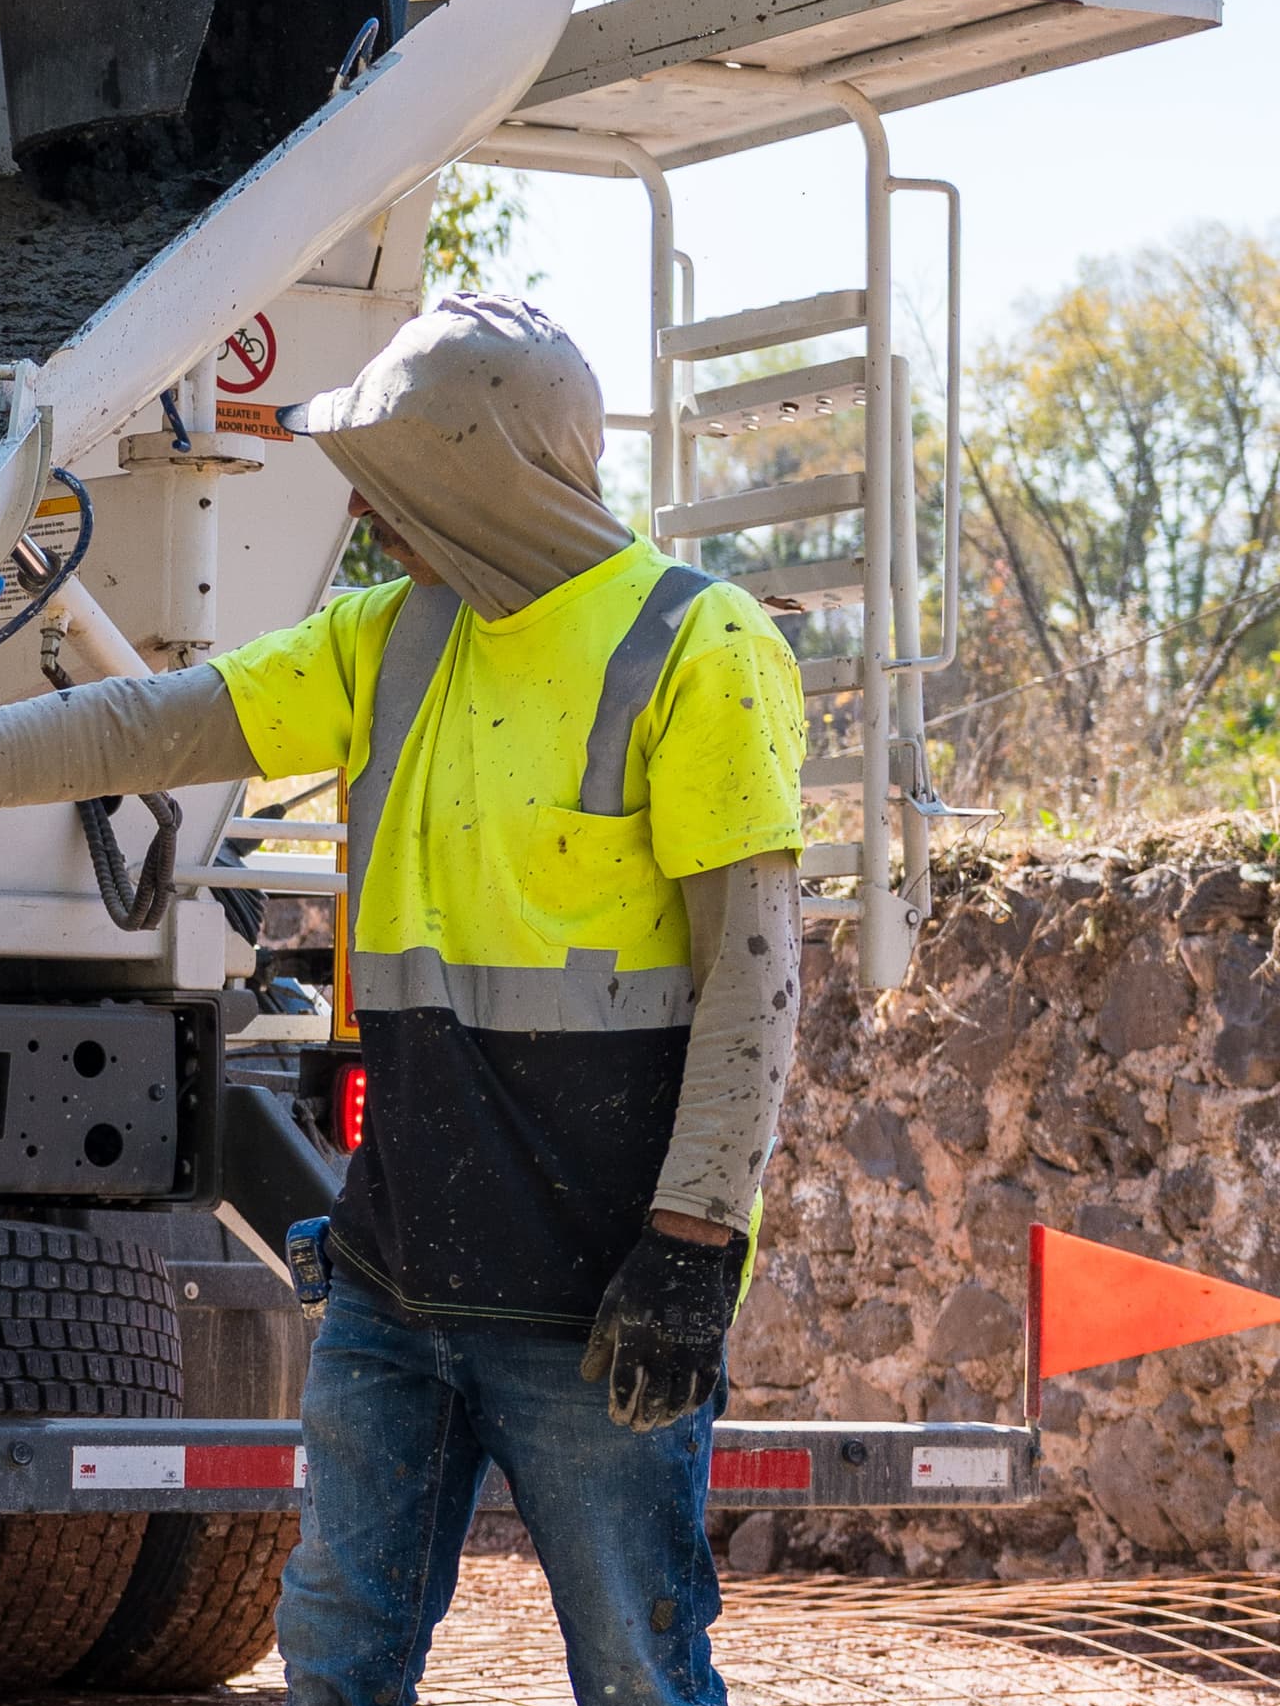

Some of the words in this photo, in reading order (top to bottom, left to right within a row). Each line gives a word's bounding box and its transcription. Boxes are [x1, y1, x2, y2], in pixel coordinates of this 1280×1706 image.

[216, 420, 243, 432] ADOR
[244, 423, 258, 433] NO
[259, 425, 271, 434] TE
[79, 1463, 96, 1474] 3M
[918, 1463, 932, 1475] 3M
